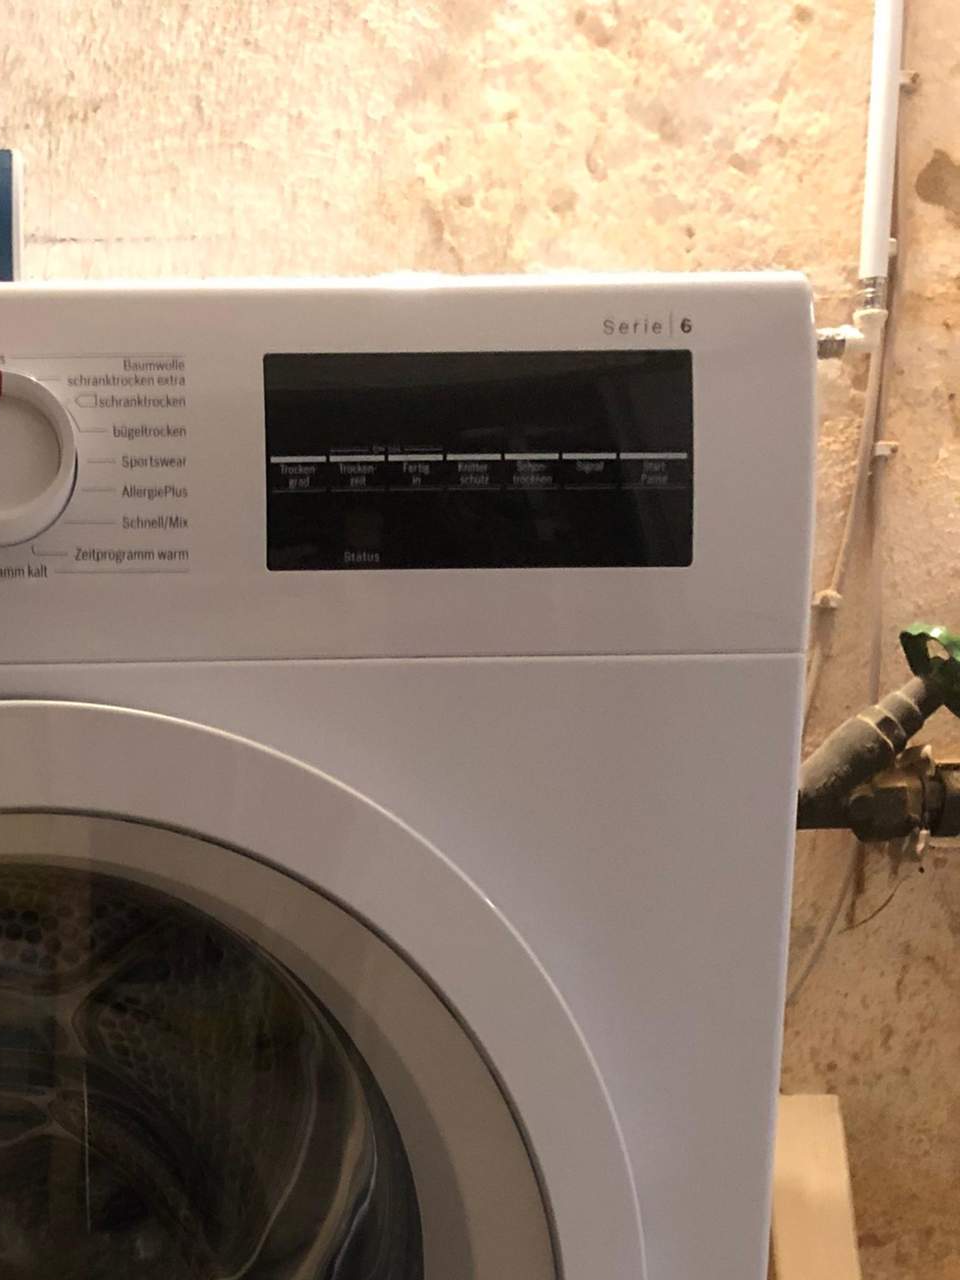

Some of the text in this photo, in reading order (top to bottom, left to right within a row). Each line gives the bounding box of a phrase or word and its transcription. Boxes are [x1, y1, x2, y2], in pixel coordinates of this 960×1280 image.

[602, 316, 692, 335] Serie 6
[123, 358, 185, 371] Baumwolle
[67, 373, 186, 388] schranktrocken extra
[98, 396, 186, 410] schranktrocken
[113, 423, 187, 439] bügeltrocken
[121, 454, 187, 469] Sportswear
[121, 485, 188, 500] AllergiePlus
[121, 514, 188, 530] Schnell/Mix
[74, 547, 189, 563] Zeitprogramm warm
[343, 551, 381, 564] Status
[27, 563, 48, 578] kalt
